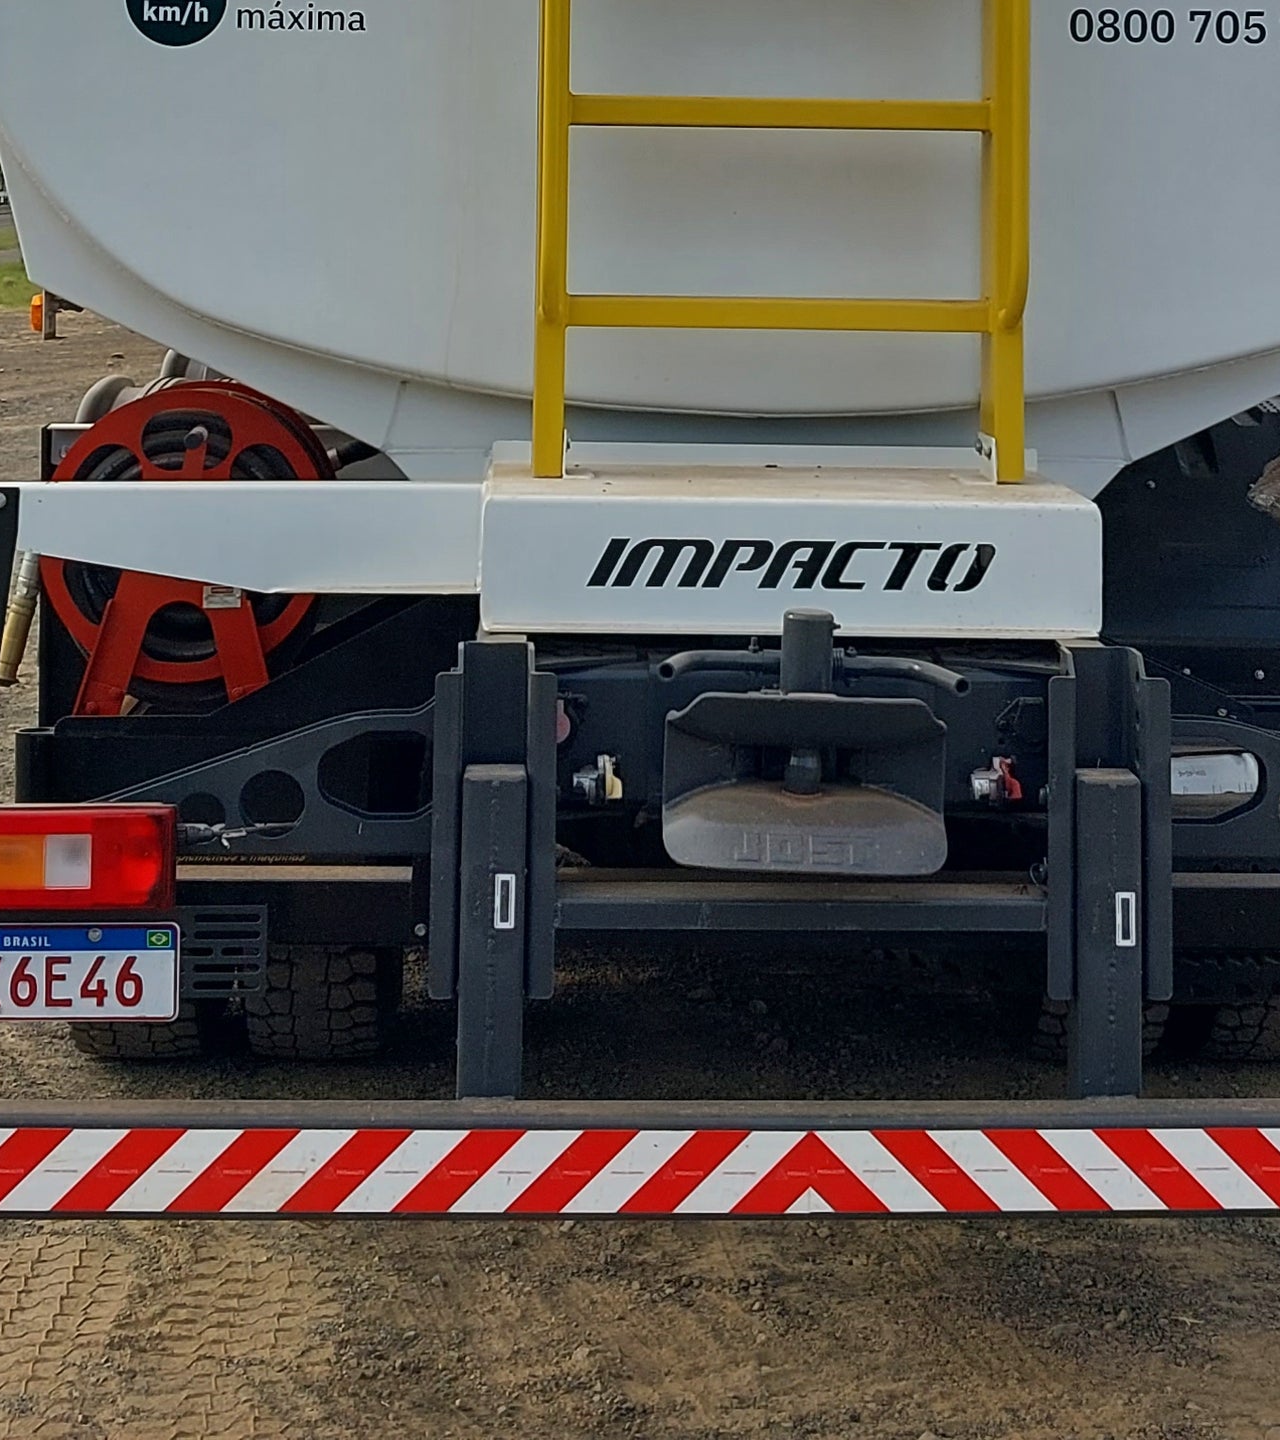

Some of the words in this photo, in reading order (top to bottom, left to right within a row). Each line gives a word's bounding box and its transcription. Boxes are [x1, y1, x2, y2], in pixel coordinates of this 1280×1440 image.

[143, 1, 209, 26] km/h
[238, 1, 365, 31] máxima
[1070, 9, 1174, 43] 0800
[1190, 11, 1266, 43] 705
[587, 539, 995, 591] IMPACTO
[3, 936, 51, 948] BRASIL
